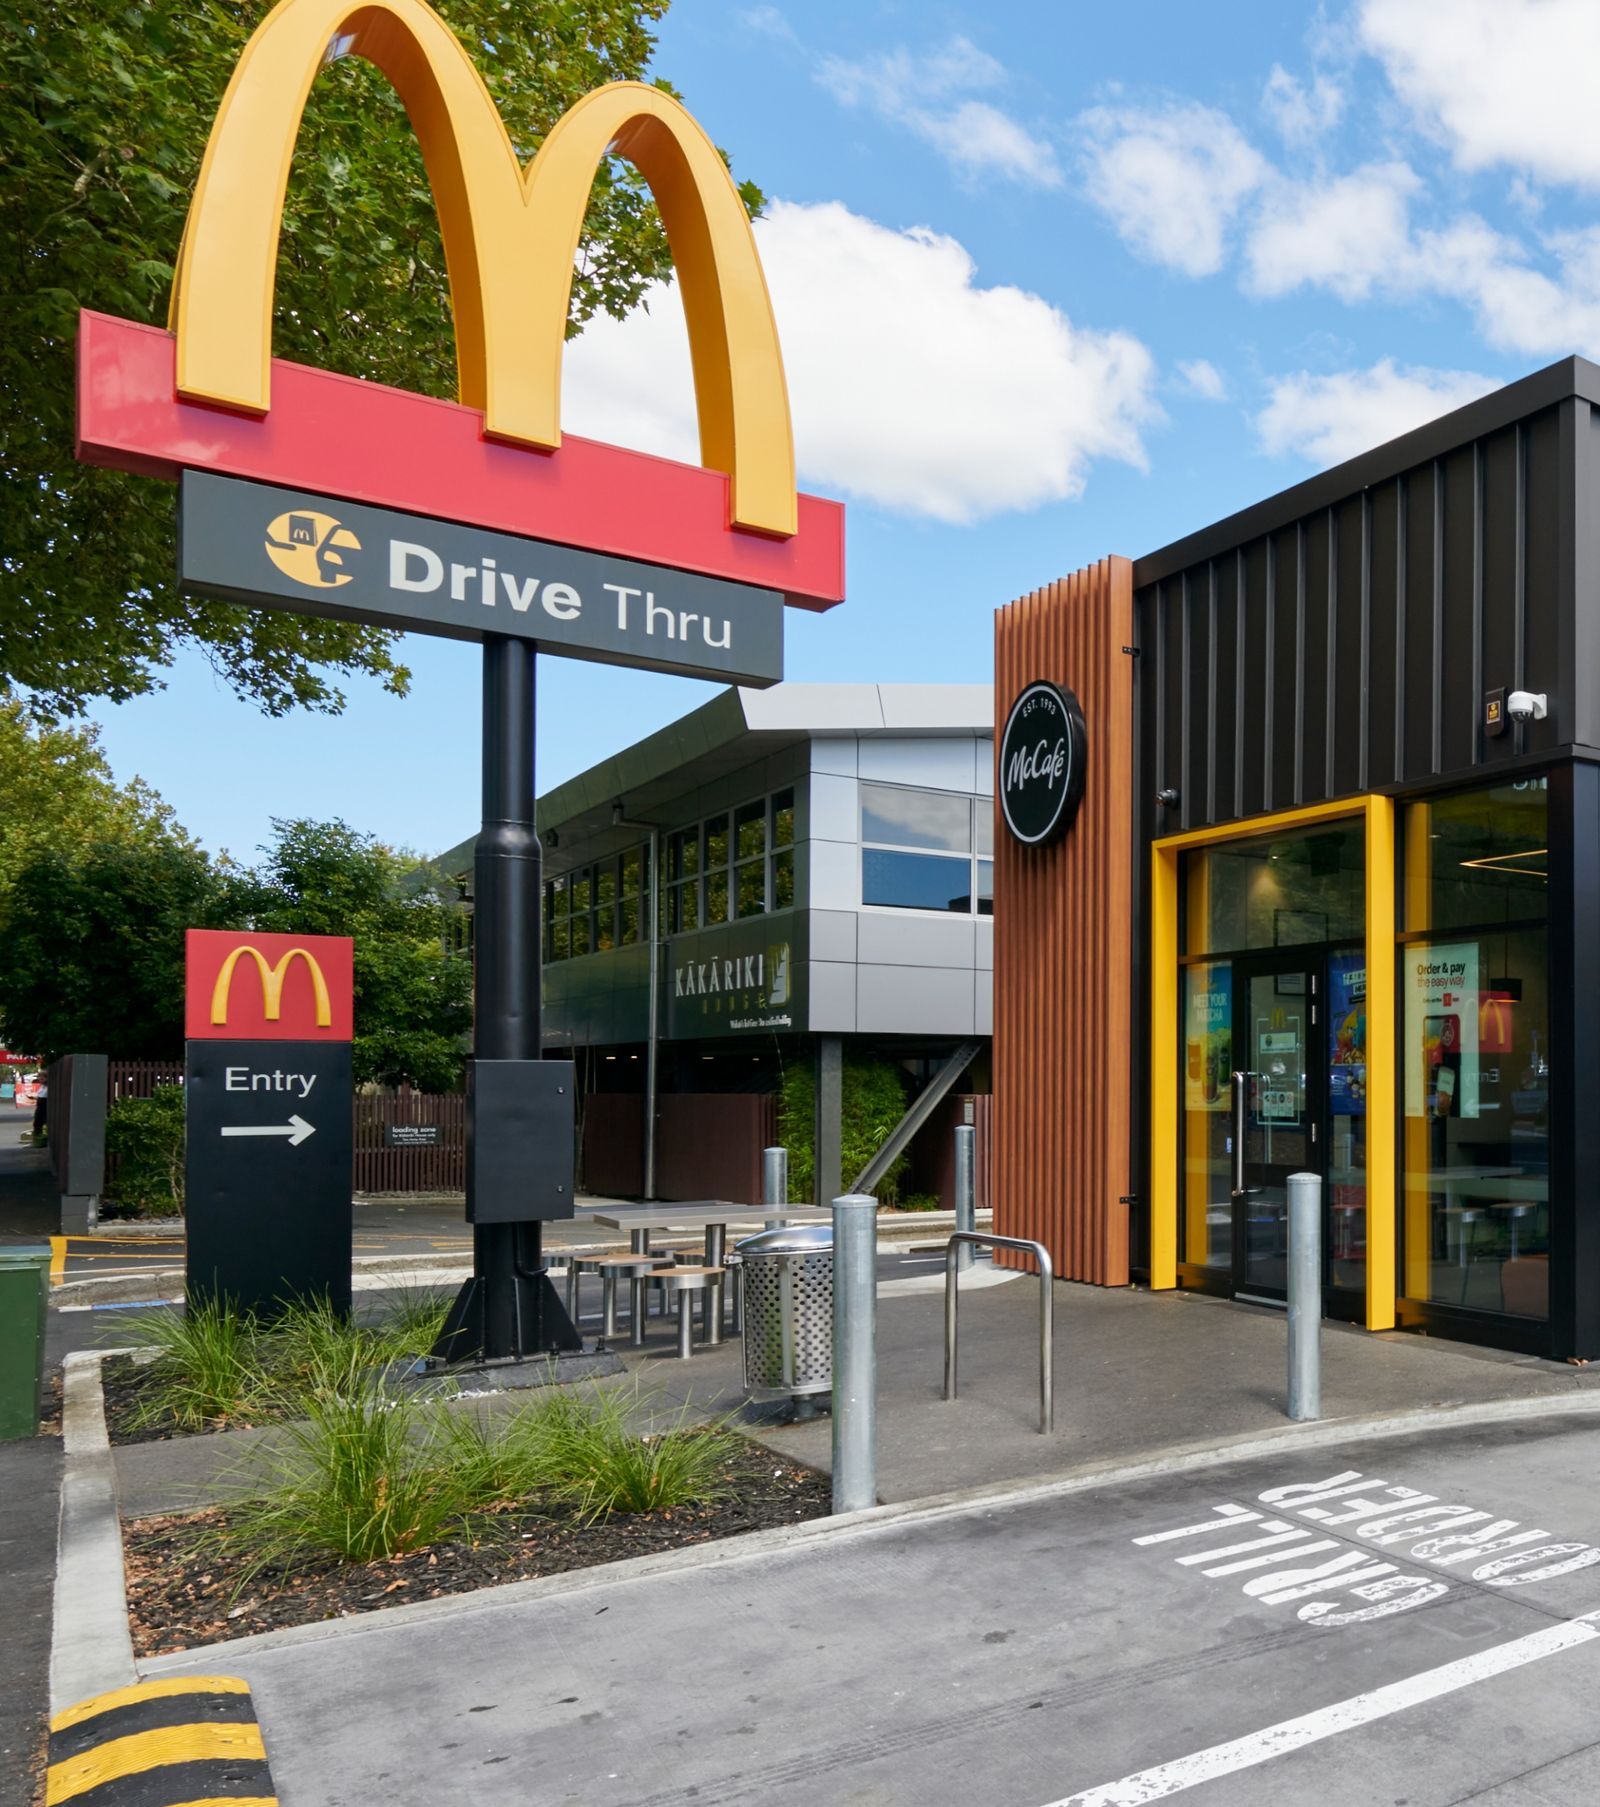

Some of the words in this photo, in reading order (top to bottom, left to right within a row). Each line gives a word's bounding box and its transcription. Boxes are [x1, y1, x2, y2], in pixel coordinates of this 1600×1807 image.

[389, 539, 582, 620] Drive
[603, 583, 731, 649] Thru
[1022, 699, 1038, 718] EST.
[1040, 697, 1056, 715] 1993
[1007, 737, 1065, 792] McCafé
[675, 953, 764, 997] KĀKĀRIKI
[1417, 962, 1440, 975] Order
[1442, 962, 1449, 974] &
[1450, 963, 1466, 976] pay
[1417, 976, 1430, 988] the
[1431, 977, 1448, 989] easy
[1450, 975, 1465, 989] way
[225, 1066, 316, 1098] Entry
[392, 1126, 418, 1134] loading
